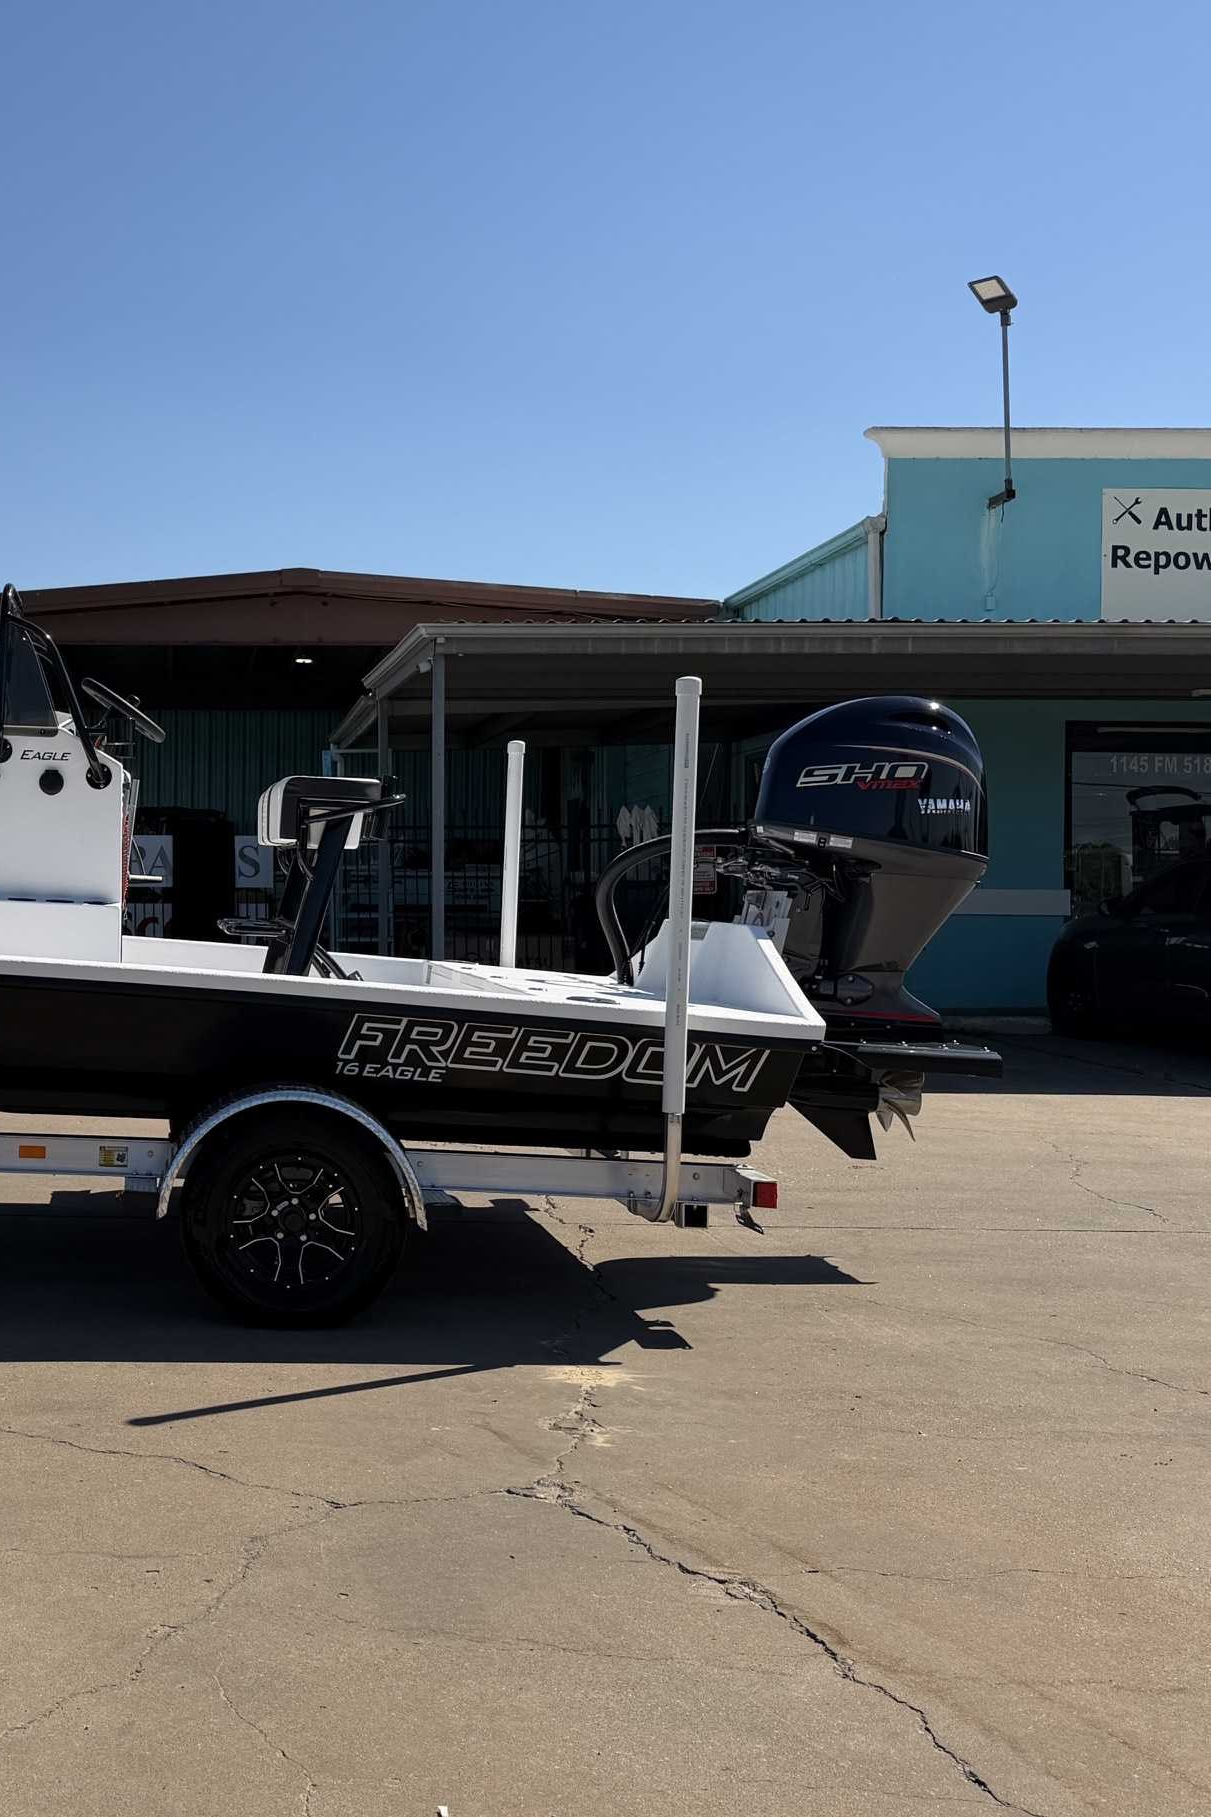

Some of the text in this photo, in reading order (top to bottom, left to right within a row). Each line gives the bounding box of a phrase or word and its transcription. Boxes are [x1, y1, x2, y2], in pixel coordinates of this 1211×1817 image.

[1152, 507, 1211, 532] Aut
[20, 749, 72, 761] EAGLE
[1110, 755, 1148, 773] 1145
[1154, 756, 1178, 773] FM
[796, 762, 929, 788] SHO
[917, 798, 971, 813] YAMAHA
[337, 1014, 771, 1092] FREEDOM
[335, 1062, 447, 1083] 16 EAGLE
